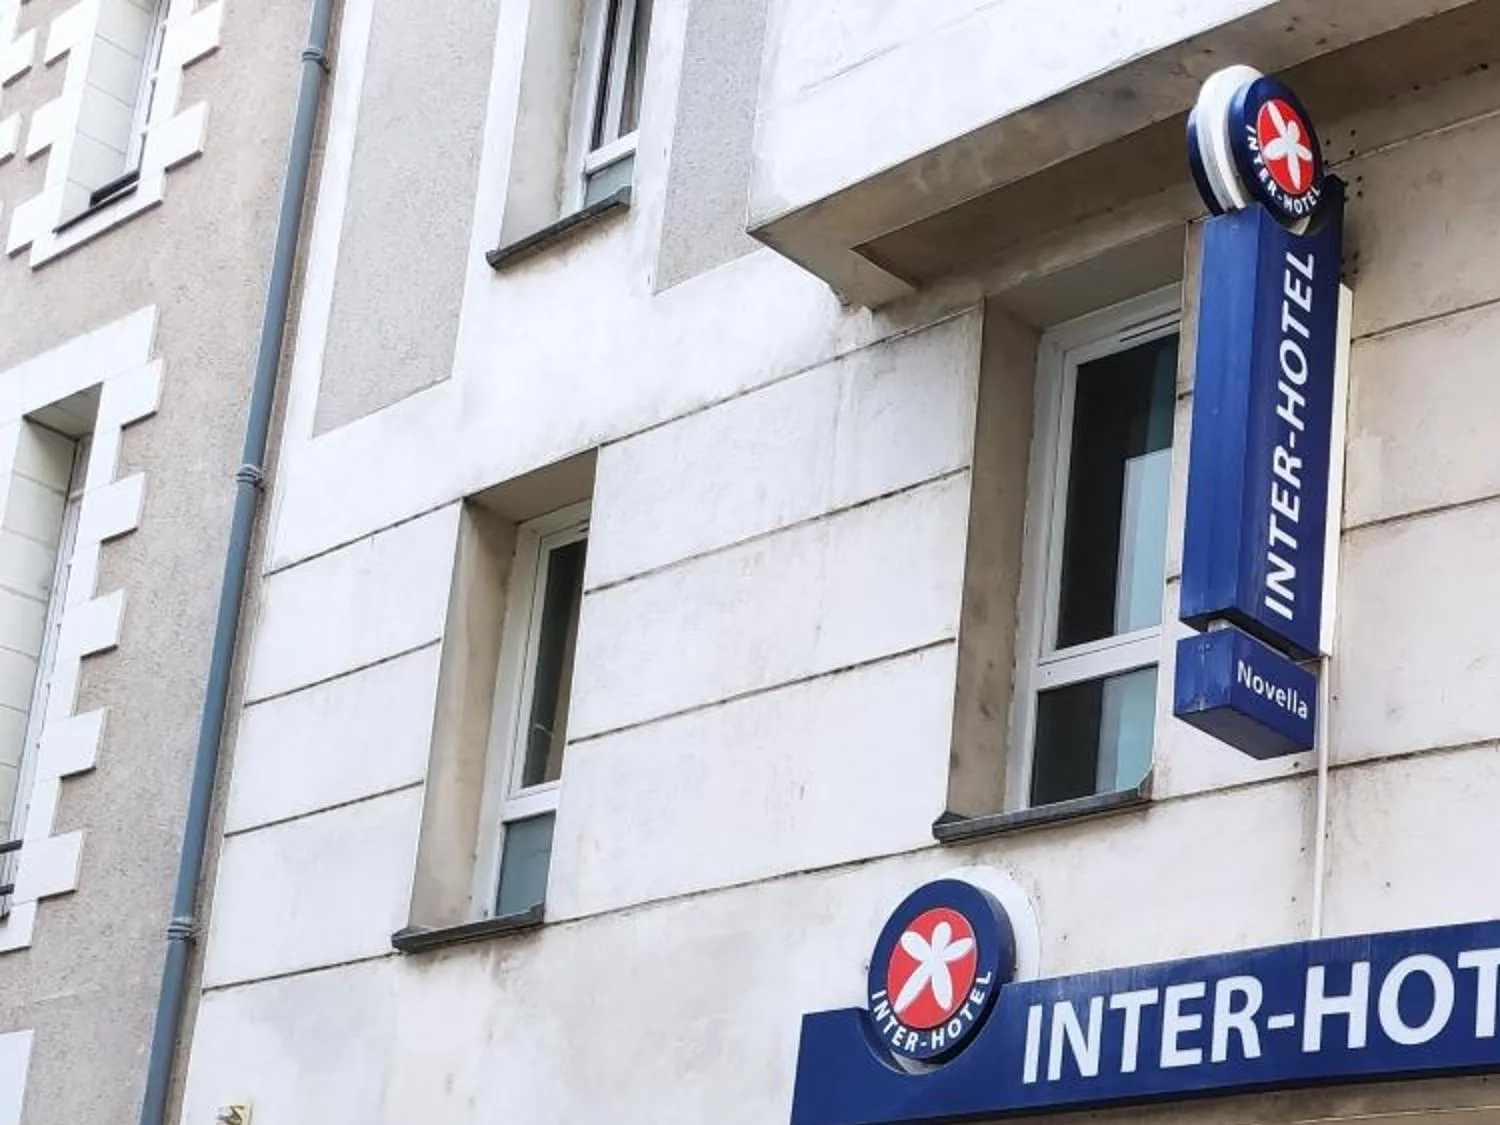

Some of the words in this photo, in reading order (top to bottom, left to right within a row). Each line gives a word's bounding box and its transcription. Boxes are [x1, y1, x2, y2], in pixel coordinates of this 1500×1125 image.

[1245, 124, 1321, 214] INTER-HOTEL
[1264, 250, 1316, 621] INTER-HOTEL
[1236, 659, 1309, 720] Novella
[871, 969, 993, 1053] INTER-HOTEL
